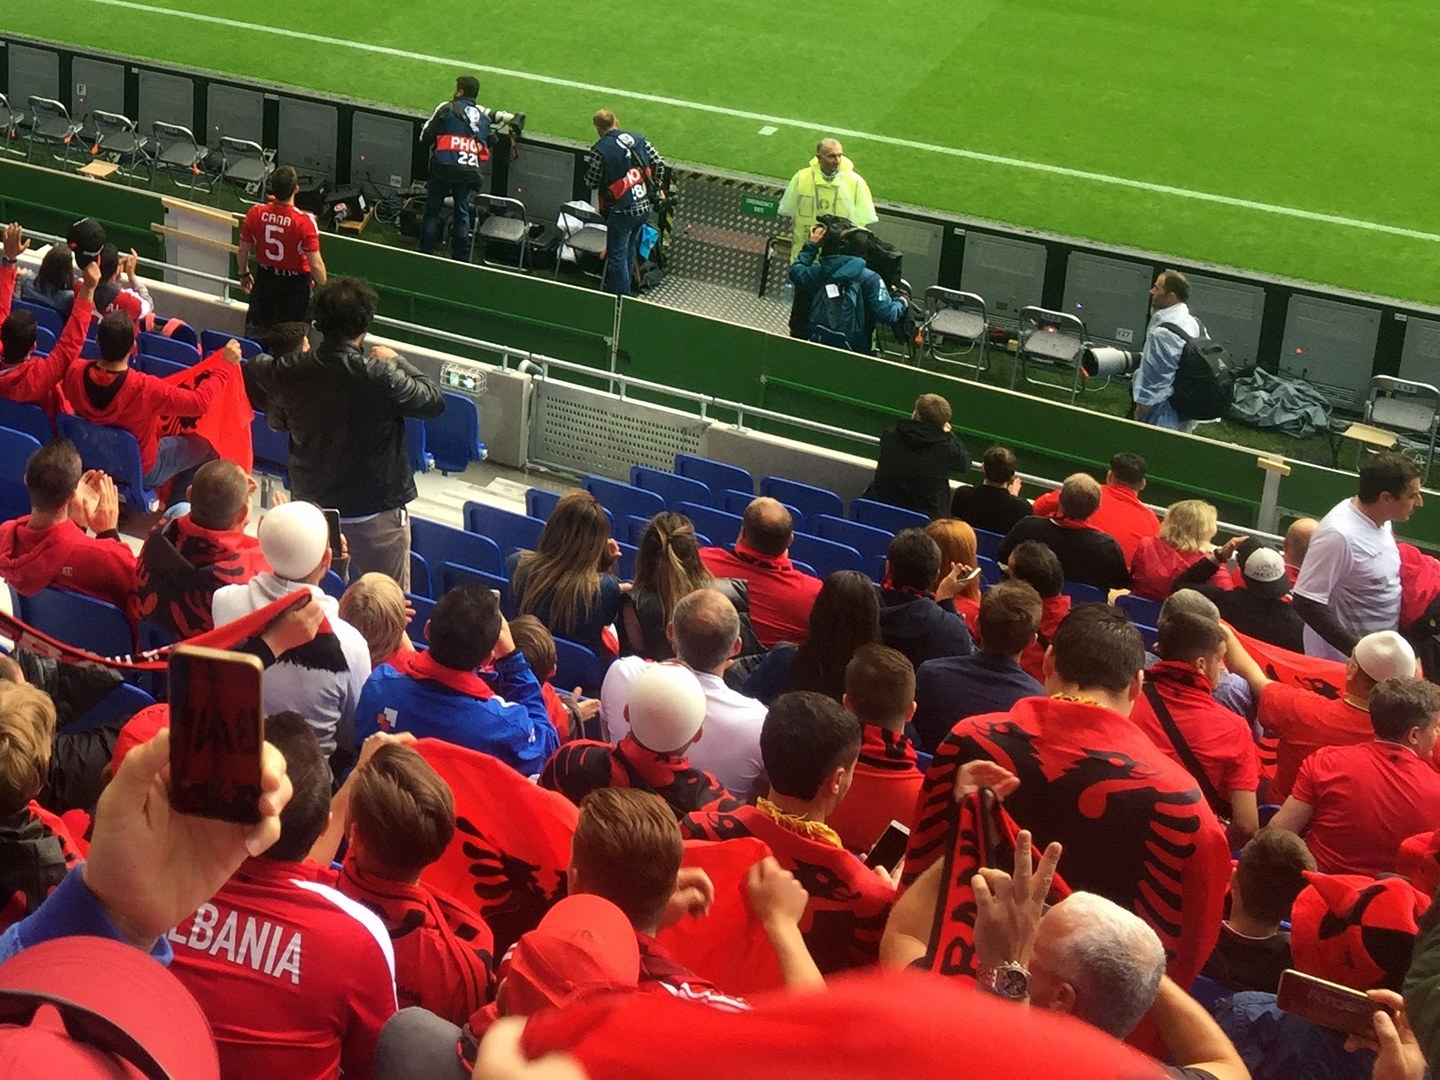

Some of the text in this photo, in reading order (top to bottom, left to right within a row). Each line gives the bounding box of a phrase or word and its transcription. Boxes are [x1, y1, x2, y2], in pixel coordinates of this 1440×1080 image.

[261, 211, 292, 227] CANA
[264, 224, 285, 262] 5
[168, 903, 303, 985] LBANIA
